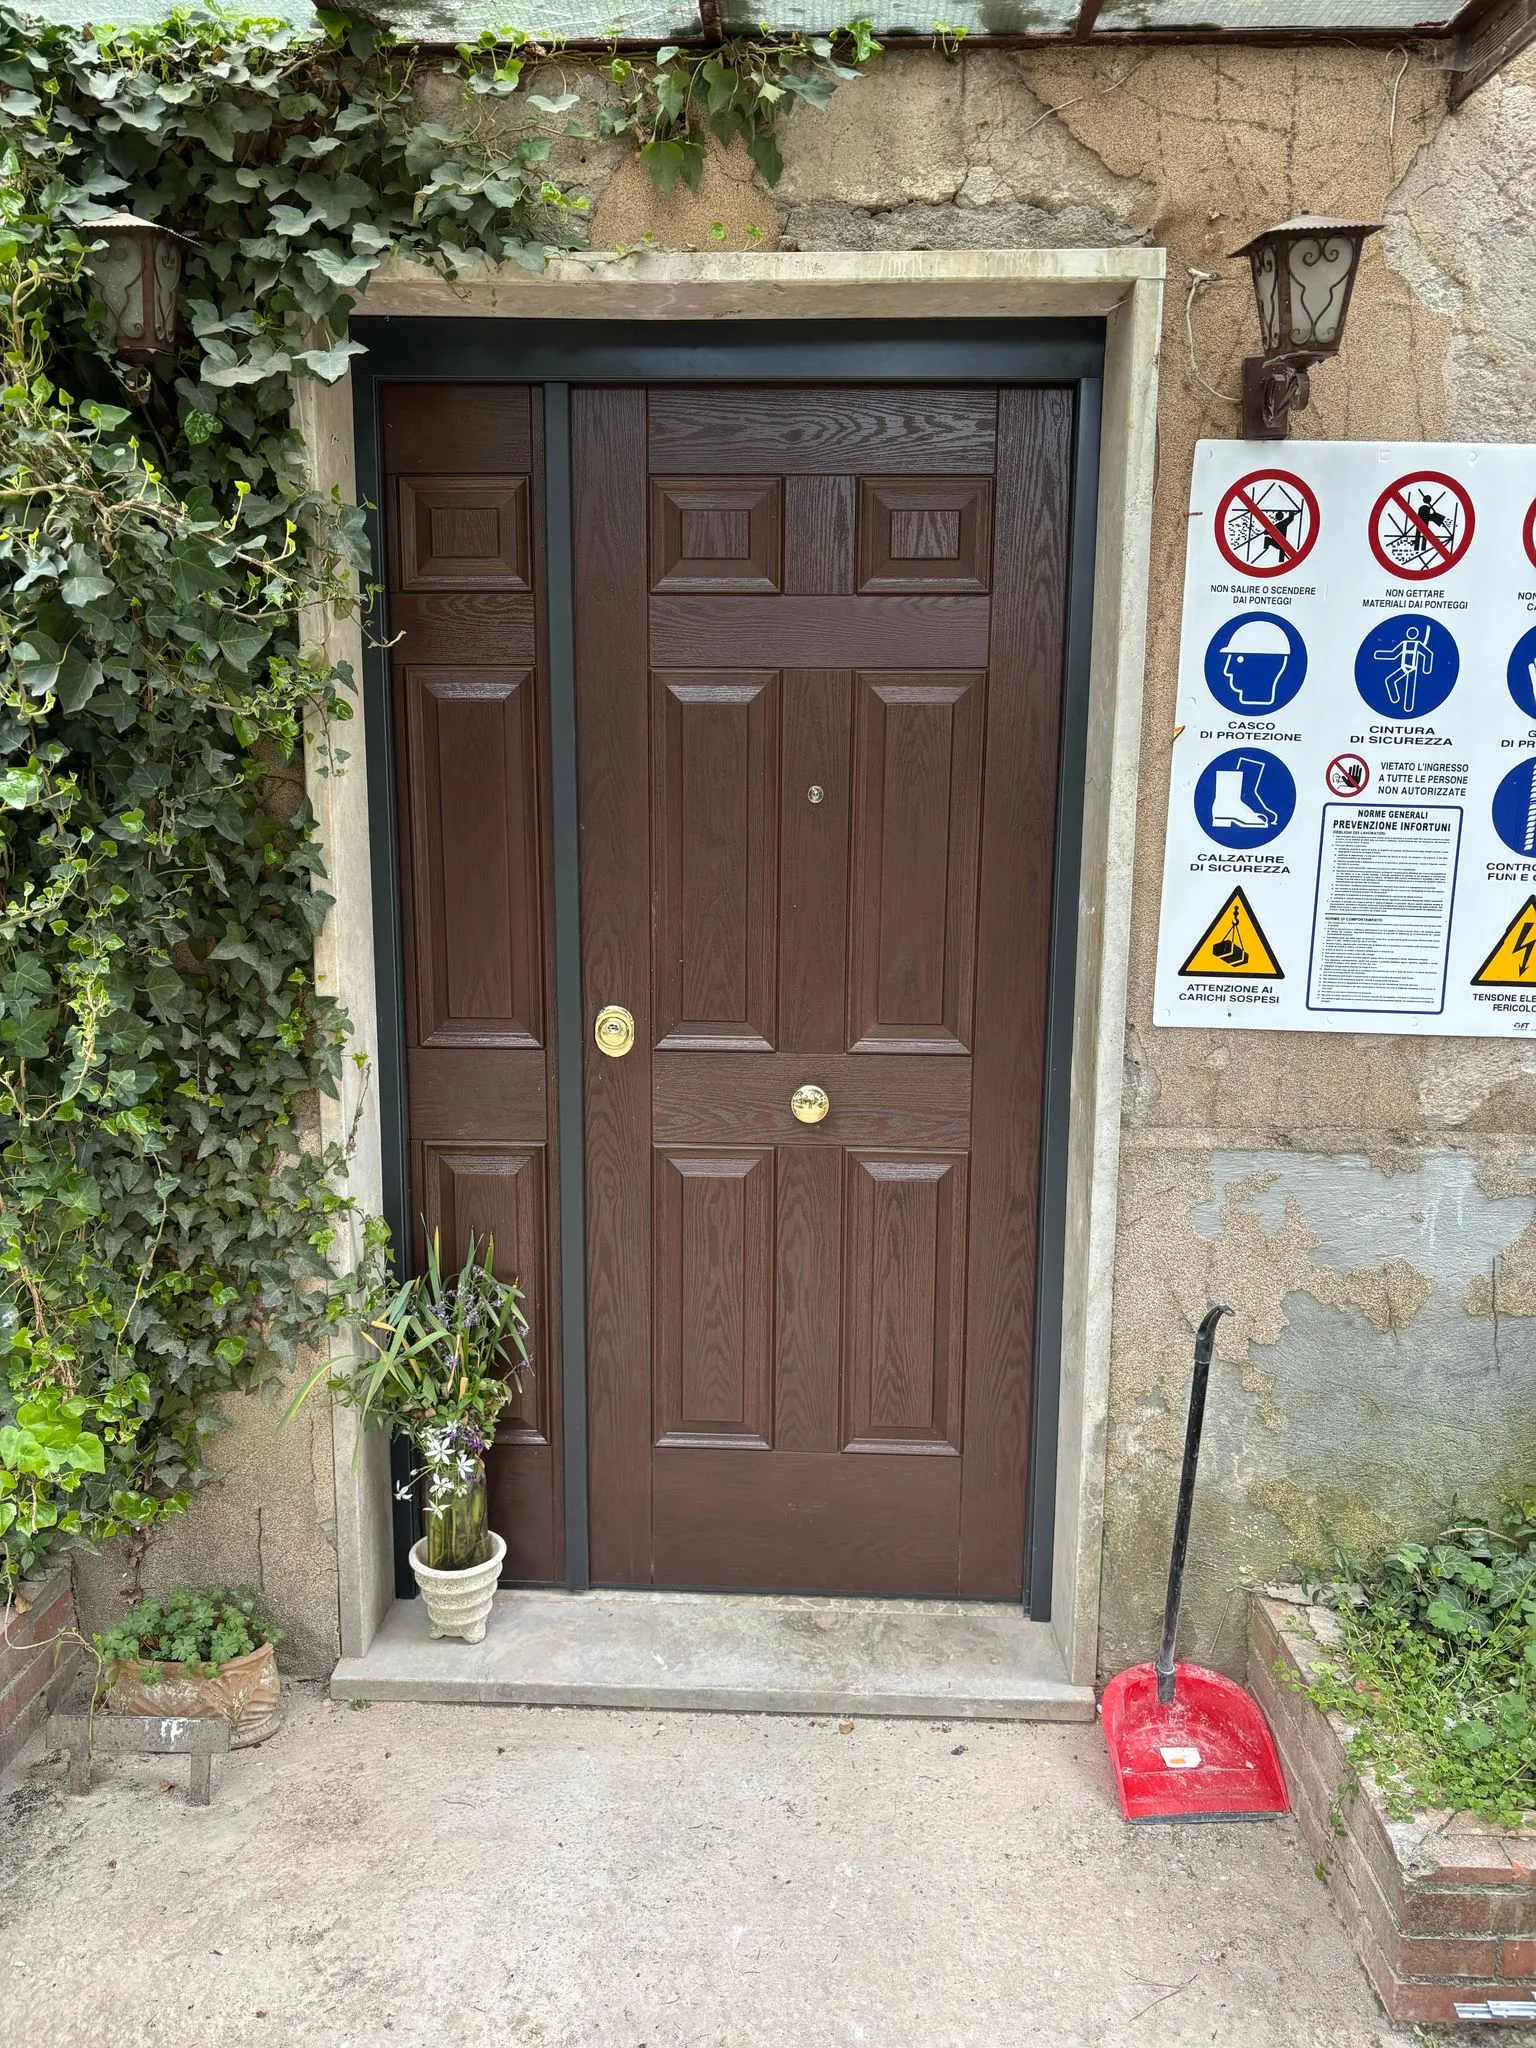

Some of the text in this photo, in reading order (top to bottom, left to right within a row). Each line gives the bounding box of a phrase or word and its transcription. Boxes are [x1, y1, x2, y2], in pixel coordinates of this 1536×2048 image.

[1211, 585, 1317, 596] NON SALIRE O SCENDERE
[1386, 589, 1445, 599] NON GETTARE
[1233, 596, 1292, 606] DAI PONTEGGI
[1363, 600, 1469, 610] MATERIALI DAI PONTEGGI
[1228, 722, 1276, 731] CASCO
[1369, 726, 1436, 735] CINTURA
[1201, 731, 1302, 742] DI PROTEZIONE
[1351, 736, 1453, 746] DI SICUREZZA
[1501, 740, 1514, 748] DI
[1381, 762, 1469, 773] VIETATO L'INGRESSO
[1379, 774, 1469, 785] A TUTTE LE PERSONE
[1378, 786, 1467, 797] NON AUTORIZZATE
[1358, 810, 1429, 820] NORME GENERALI
[1334, 820, 1451, 832] PREVENZIONE INFORTUNI
[1198, 854, 1285, 864] CALZATURE
[1190, 864, 1291, 874] DI SICUREZZA
[1488, 873, 1517, 881] FUNI
[1521, 874, 1529, 882] E
[1187, 984, 1259, 994] ATTENZIONE
[1179, 993, 1280, 1004] CARICHI SOSPESI
[1473, 994, 1518, 1002] TENSIONE
